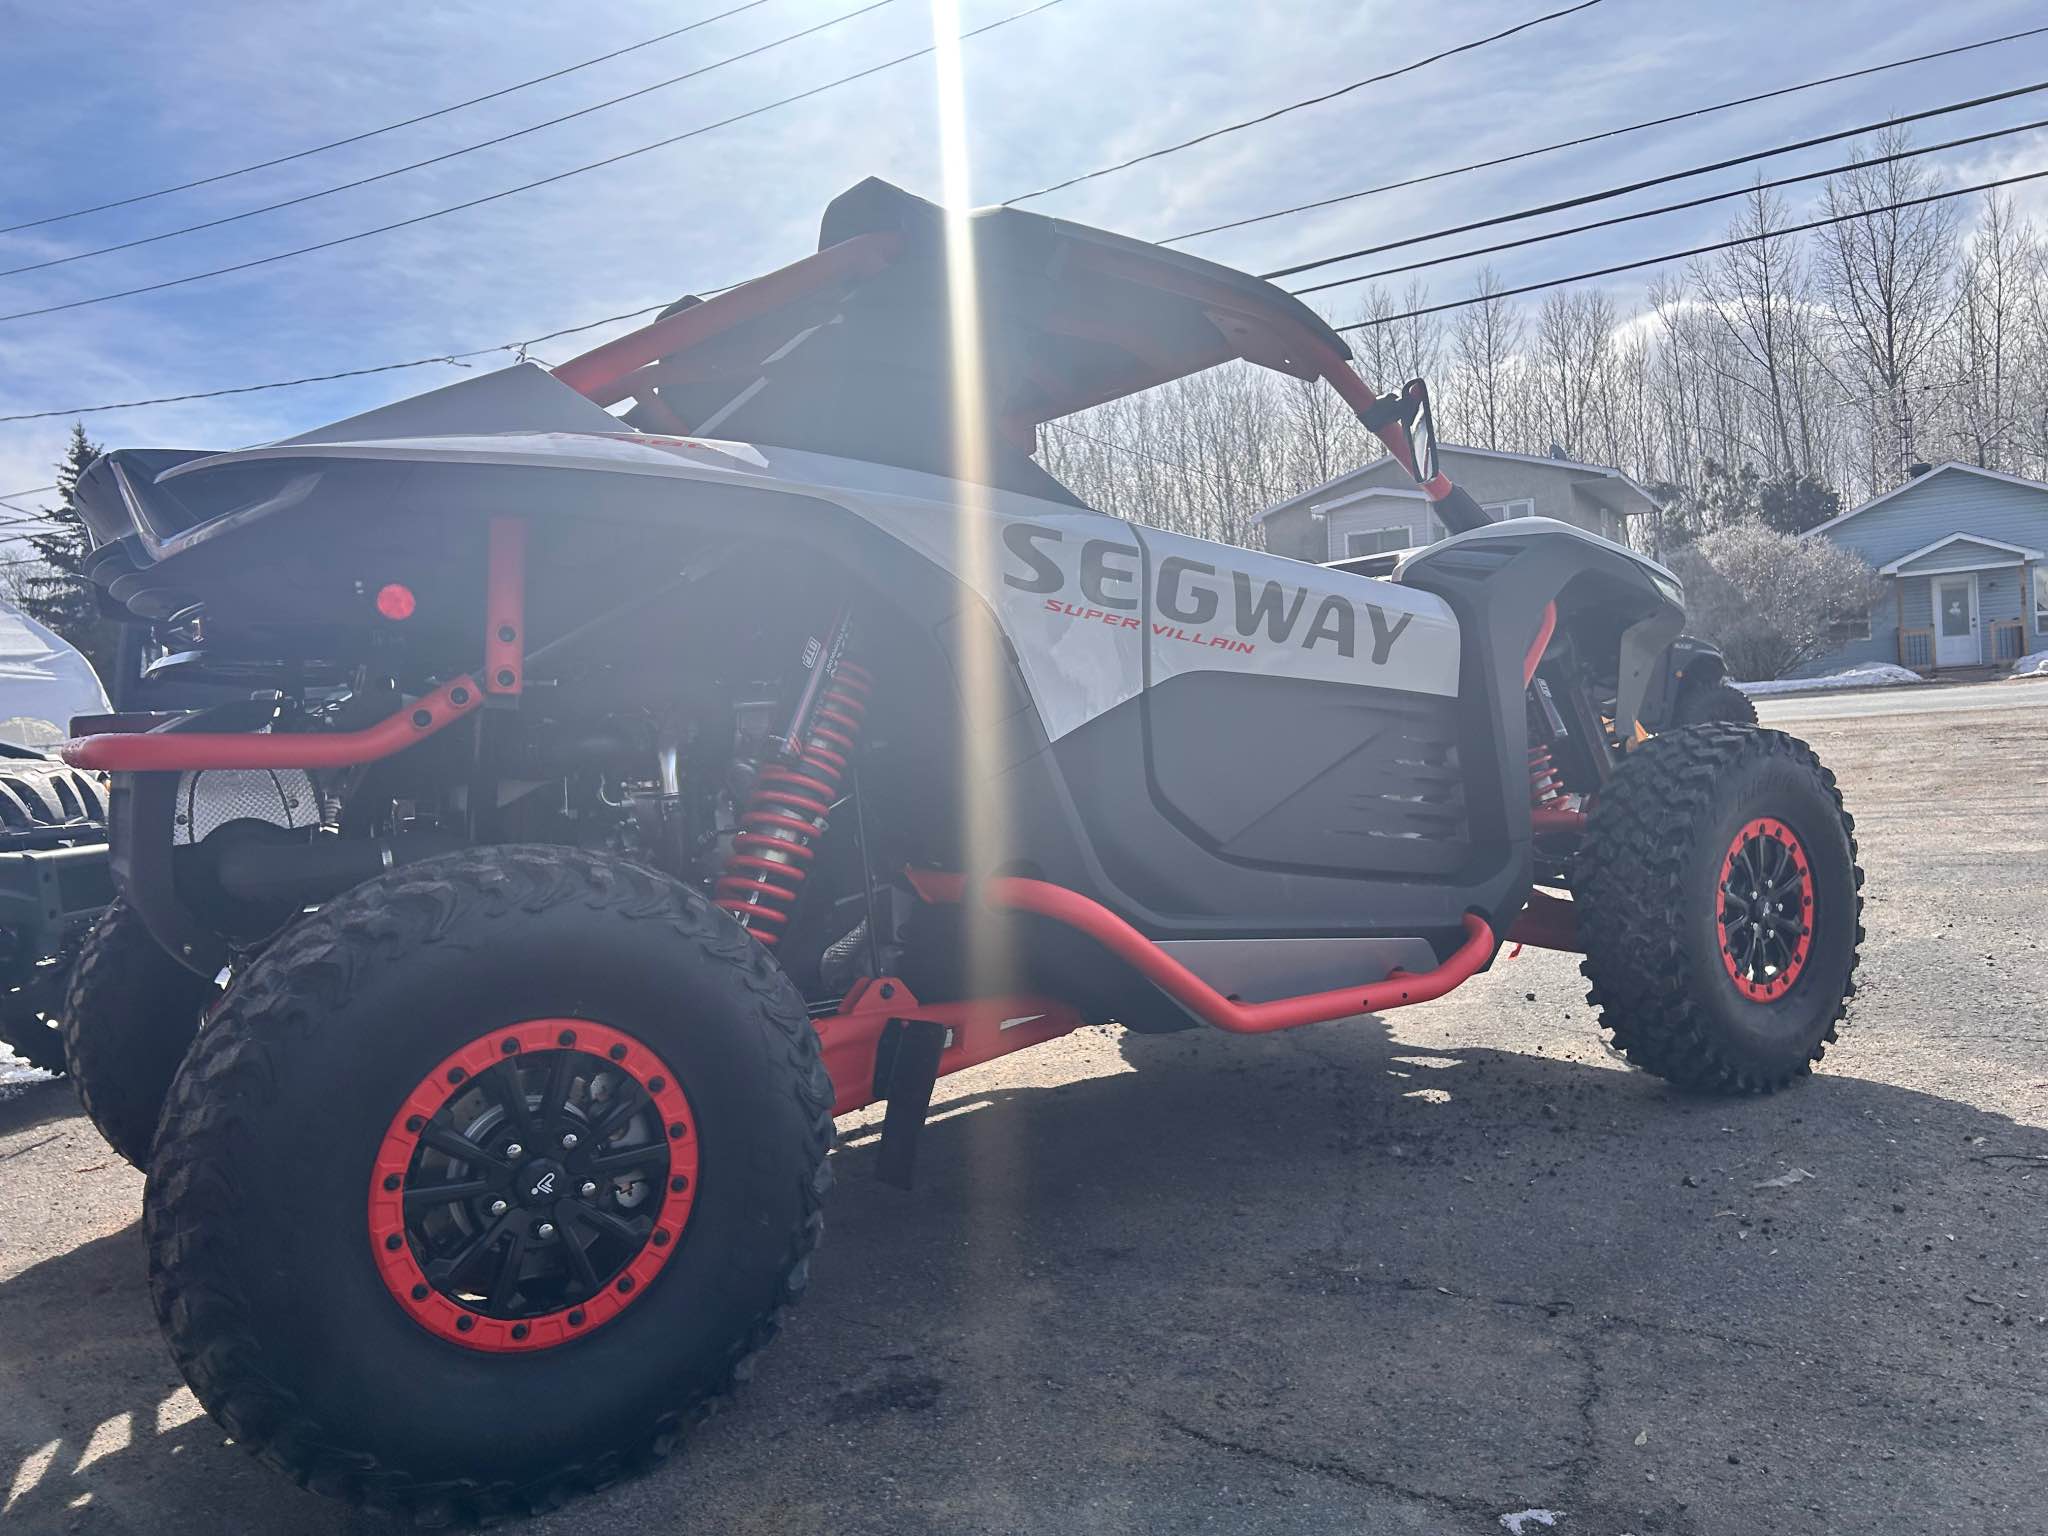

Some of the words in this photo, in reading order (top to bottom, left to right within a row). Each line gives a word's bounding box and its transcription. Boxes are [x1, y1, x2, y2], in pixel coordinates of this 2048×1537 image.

[1002, 522, 1414, 665] SEGWAY
[1044, 599, 1141, 630] SUPER
[1152, 613, 1255, 654] VILLAIN
